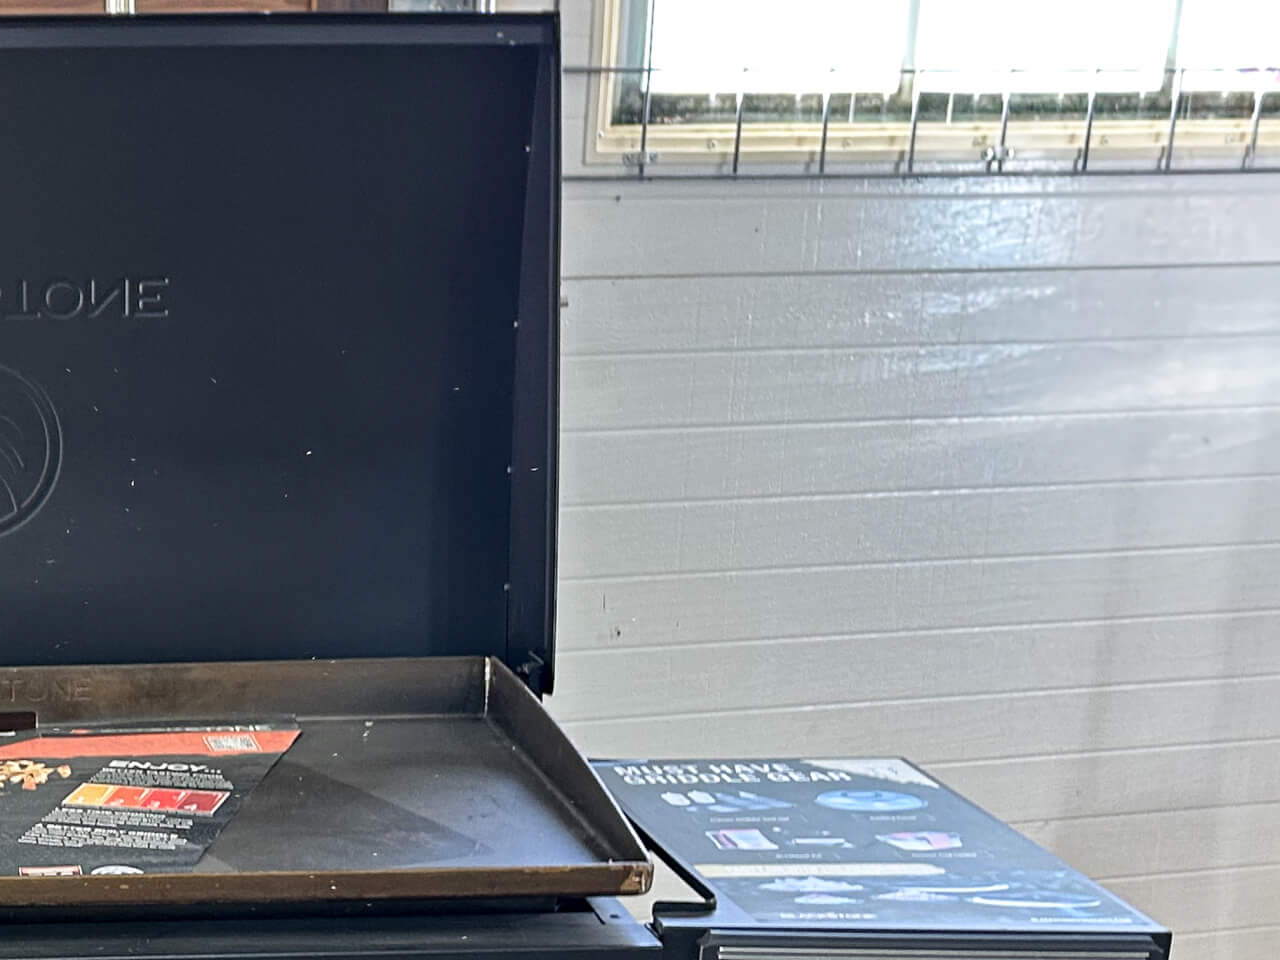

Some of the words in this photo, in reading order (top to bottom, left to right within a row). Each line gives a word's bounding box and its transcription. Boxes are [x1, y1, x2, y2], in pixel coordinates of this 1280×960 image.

[613, 765, 698, 776] MUST
[709, 763, 792, 774] HAVE
[623, 773, 761, 785] GRIDDLE
[767, 771, 851, 782] GEAR
